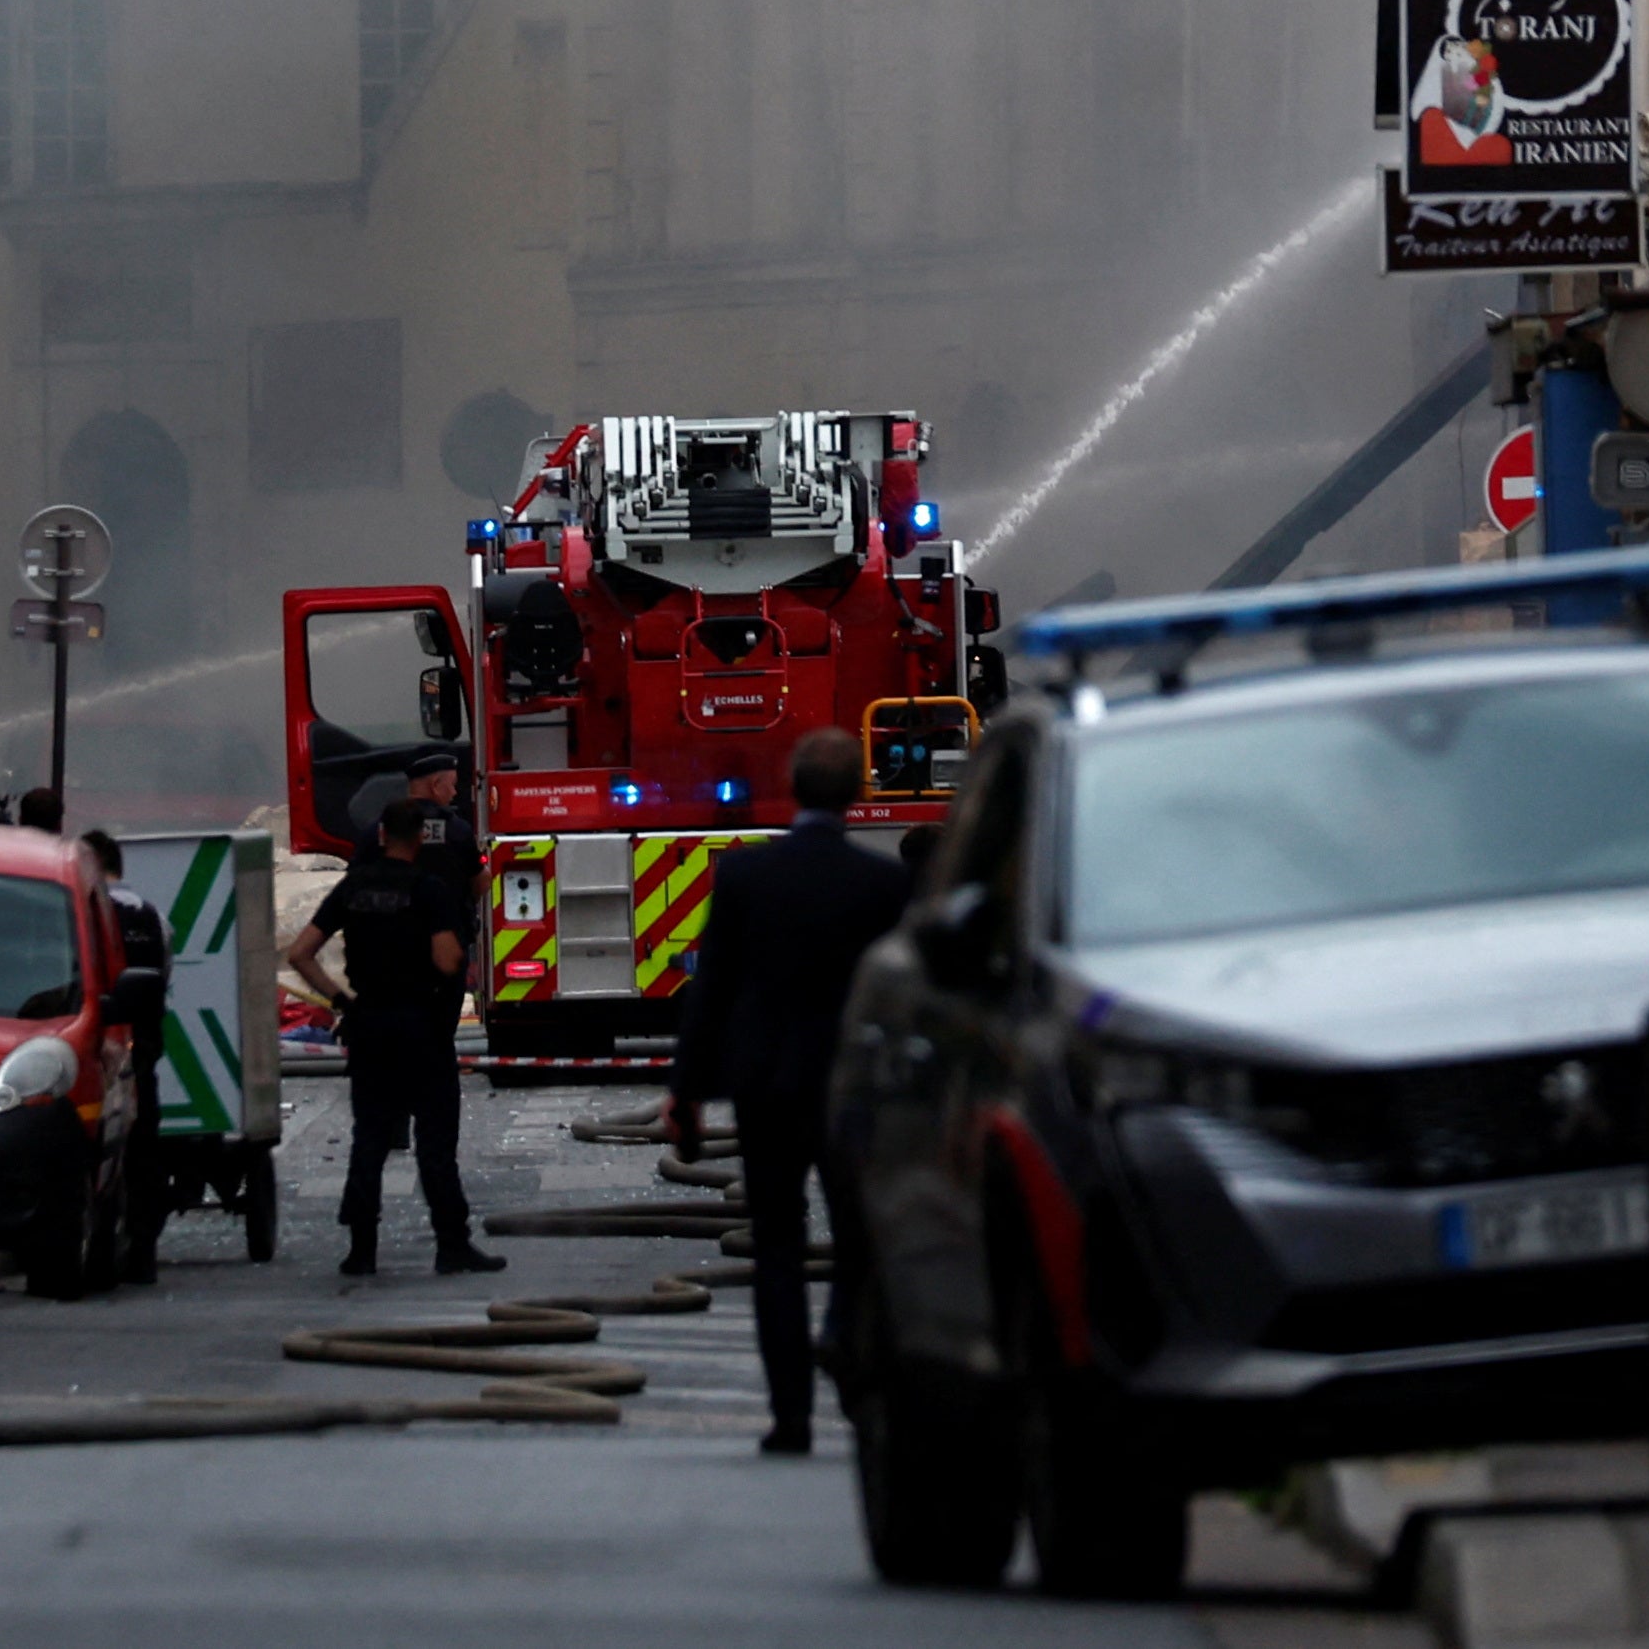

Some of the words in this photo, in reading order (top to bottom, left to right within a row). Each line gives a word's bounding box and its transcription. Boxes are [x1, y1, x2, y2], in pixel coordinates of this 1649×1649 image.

[1480, 15, 1597, 43] TORANJ
[1507, 118, 1629, 136] RESTAURANT
[1513, 141, 1629, 164] IRANIEN
[1395, 234, 1502, 257] Traiteur
[1505, 230, 1630, 259] Asiatique
[714, 694, 765, 706] ECHELLES
